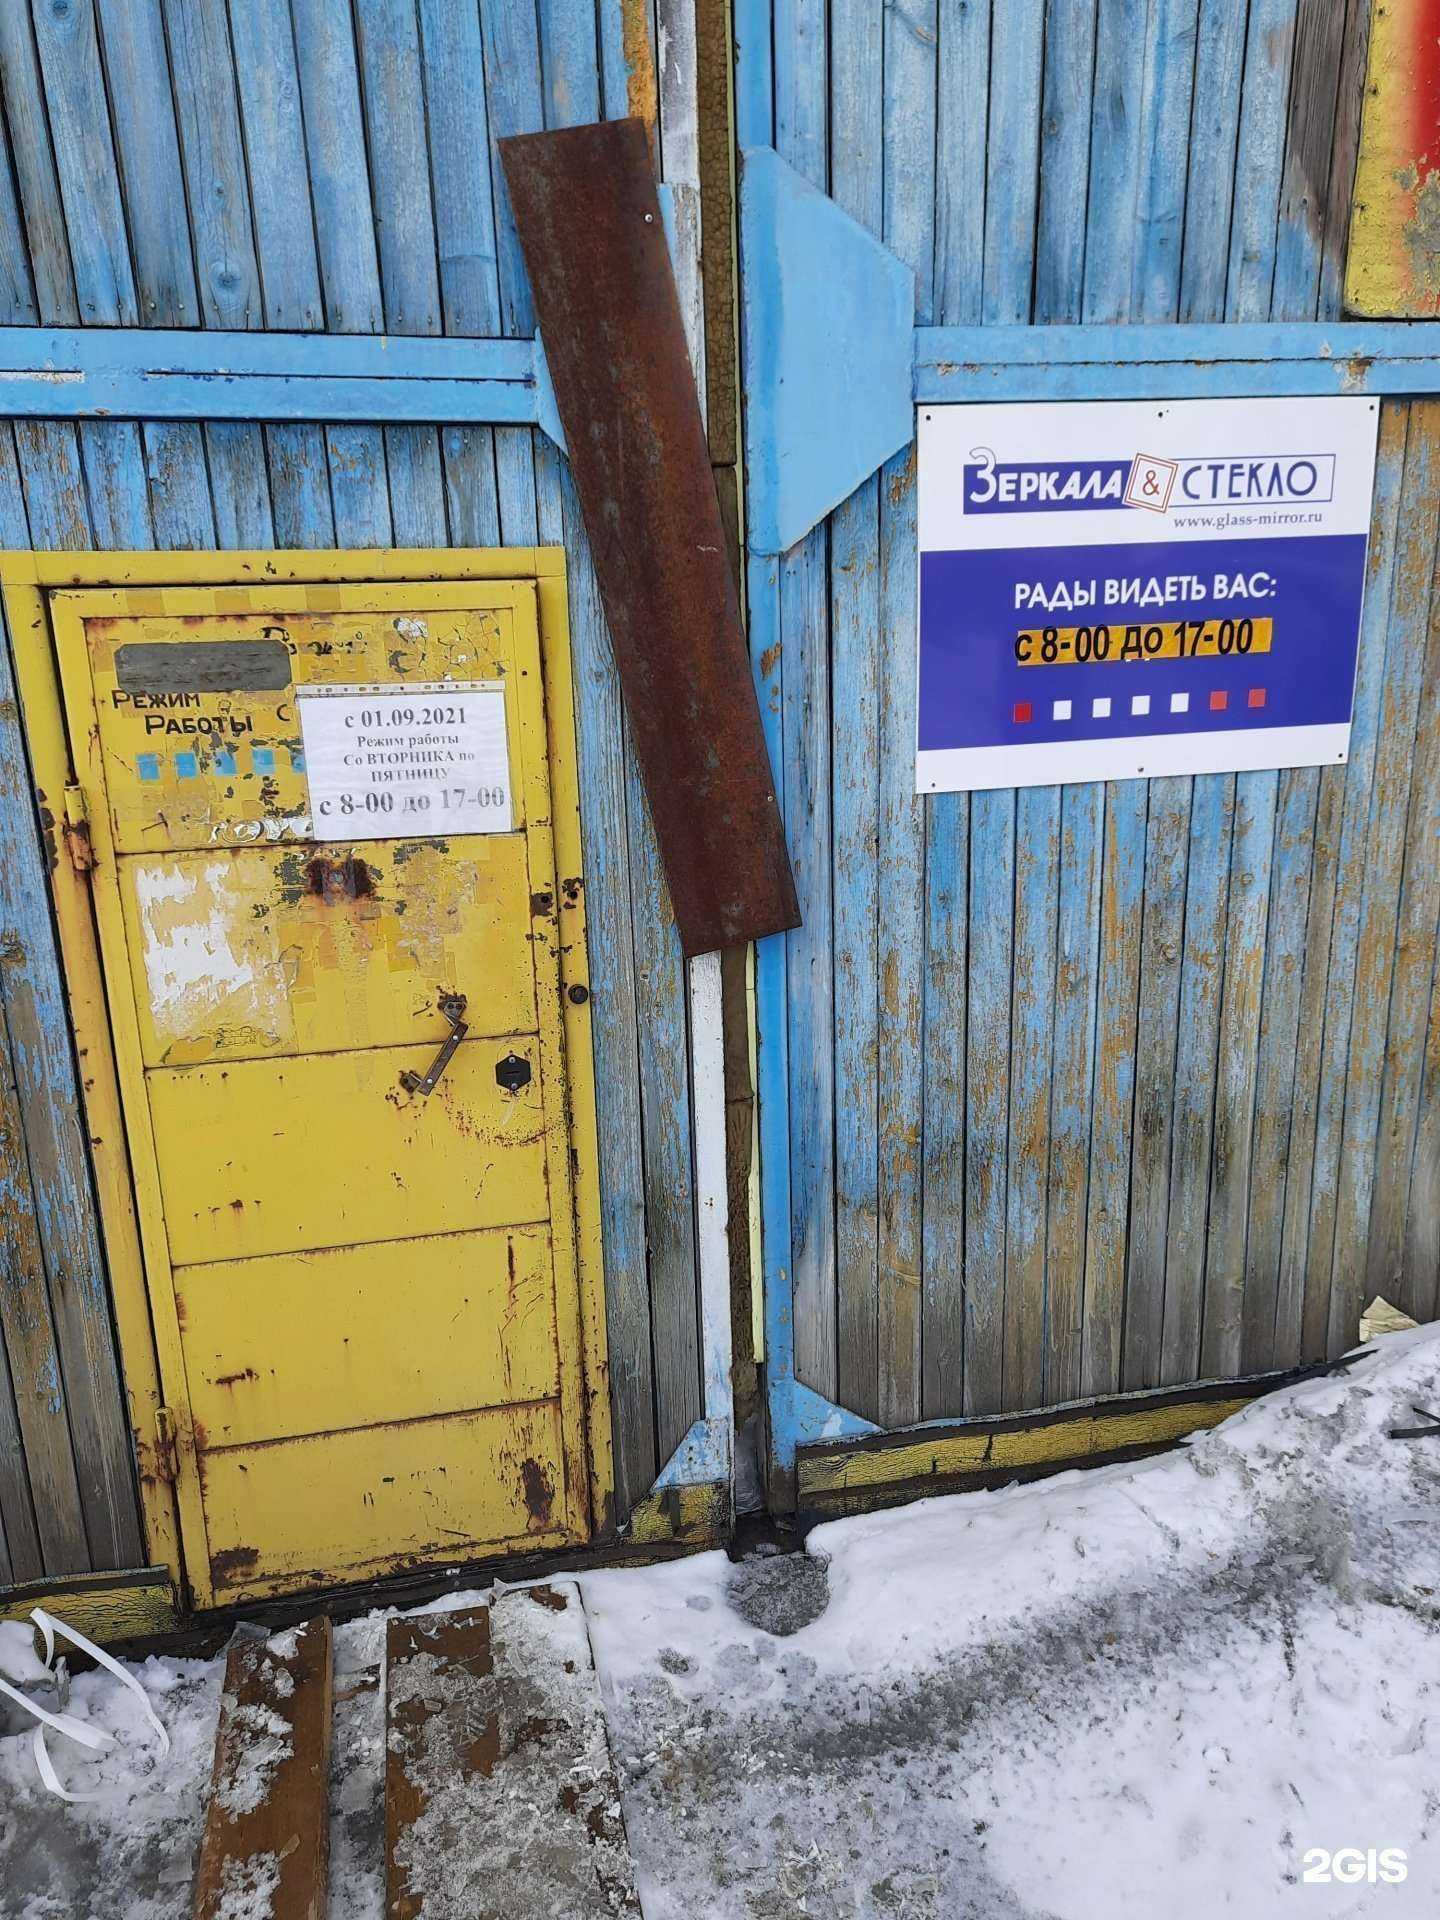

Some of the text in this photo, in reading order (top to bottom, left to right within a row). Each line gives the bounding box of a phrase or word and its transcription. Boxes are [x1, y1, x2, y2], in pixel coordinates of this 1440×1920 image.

[1142, 470, 1160, 496] &
[1182, 461, 1318, 500] СТЕКЛО
[1173, 511, 1323, 530] www.glass-mirror.ru
[1014, 571, 1277, 612] РАДЫ ВИДЕТЬ ВАС:
[1040, 624, 1110, 662] 8-00
[1173, 618, 1254, 655] 17-00
[344, 707, 467, 728] с 01.09.2021
[357, 734, 459, 748] Режим работы
[367, 750, 455, 765] ВТОРНИКА
[459, 752, 475, 761] по
[319, 786, 505, 816] с 8-00 до 17-00
